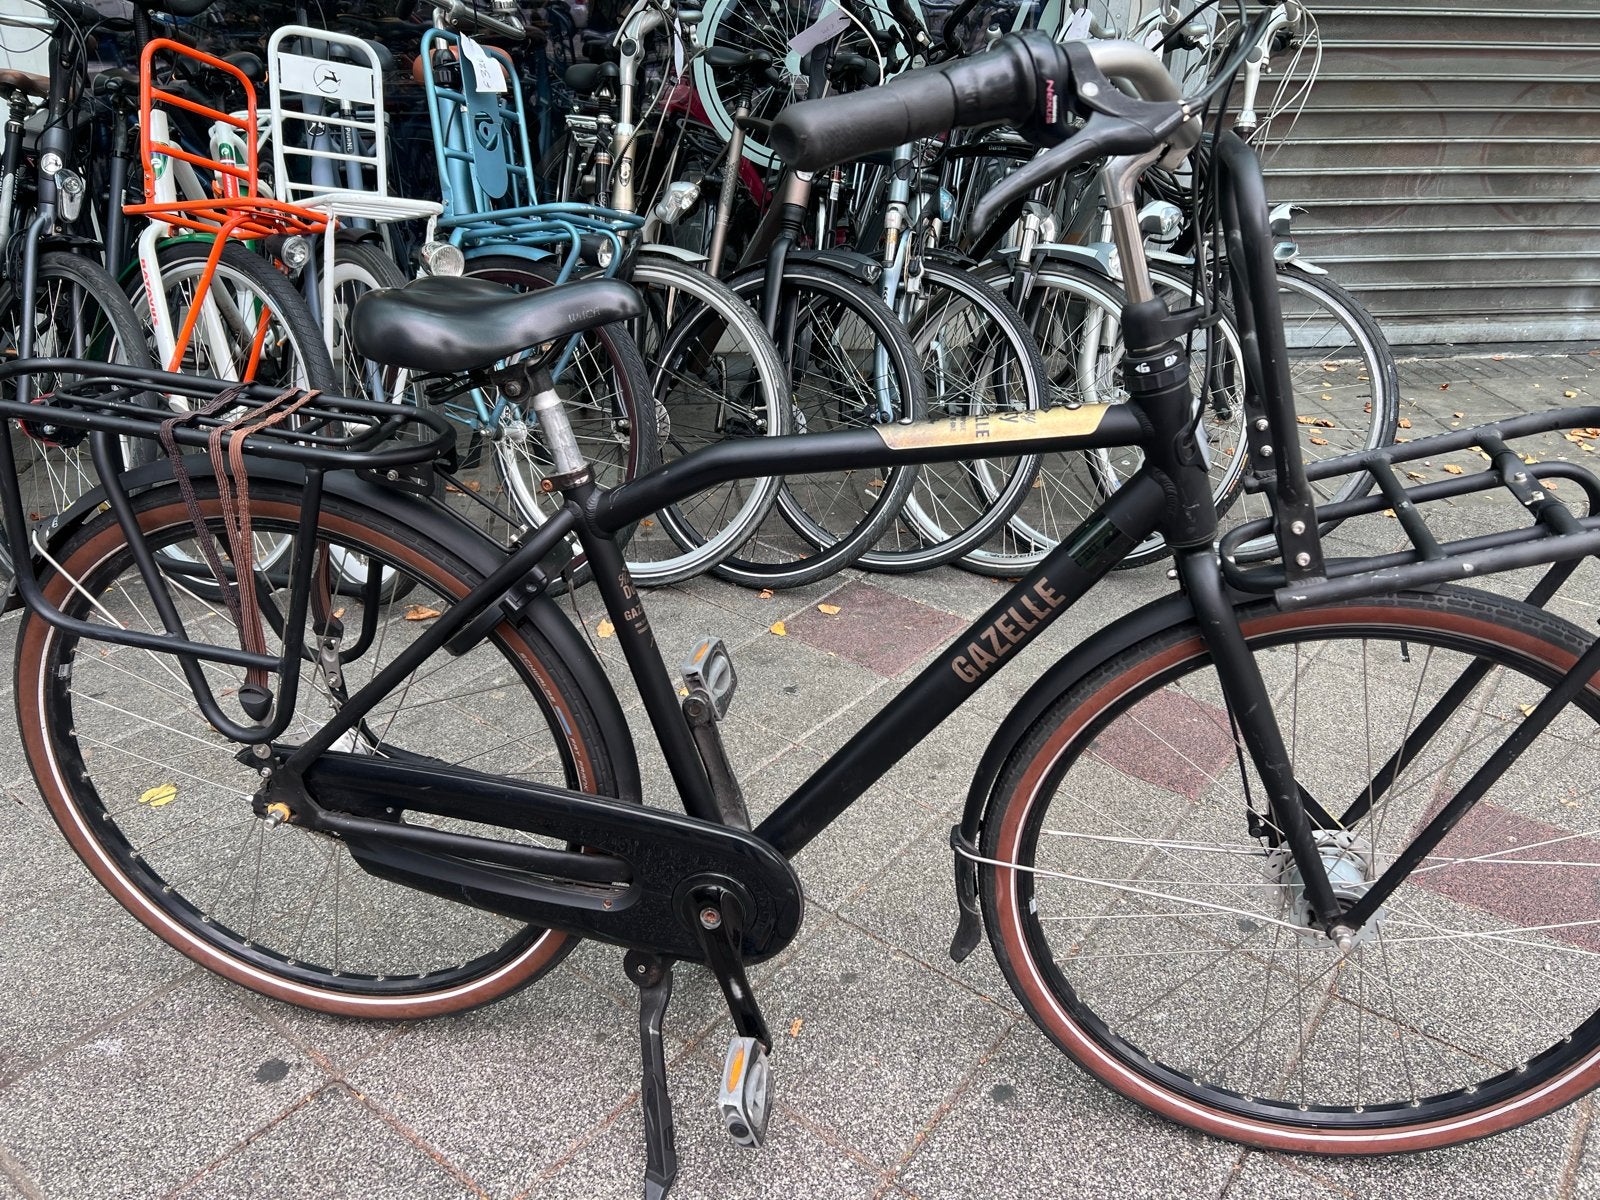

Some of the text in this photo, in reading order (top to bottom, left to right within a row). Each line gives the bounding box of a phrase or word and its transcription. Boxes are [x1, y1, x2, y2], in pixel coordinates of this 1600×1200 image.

[141, 258, 159, 326] BATAVUS
[951, 576, 1067, 684] GAZELLE
[520, 652, 556, 703] SCHWALBE
